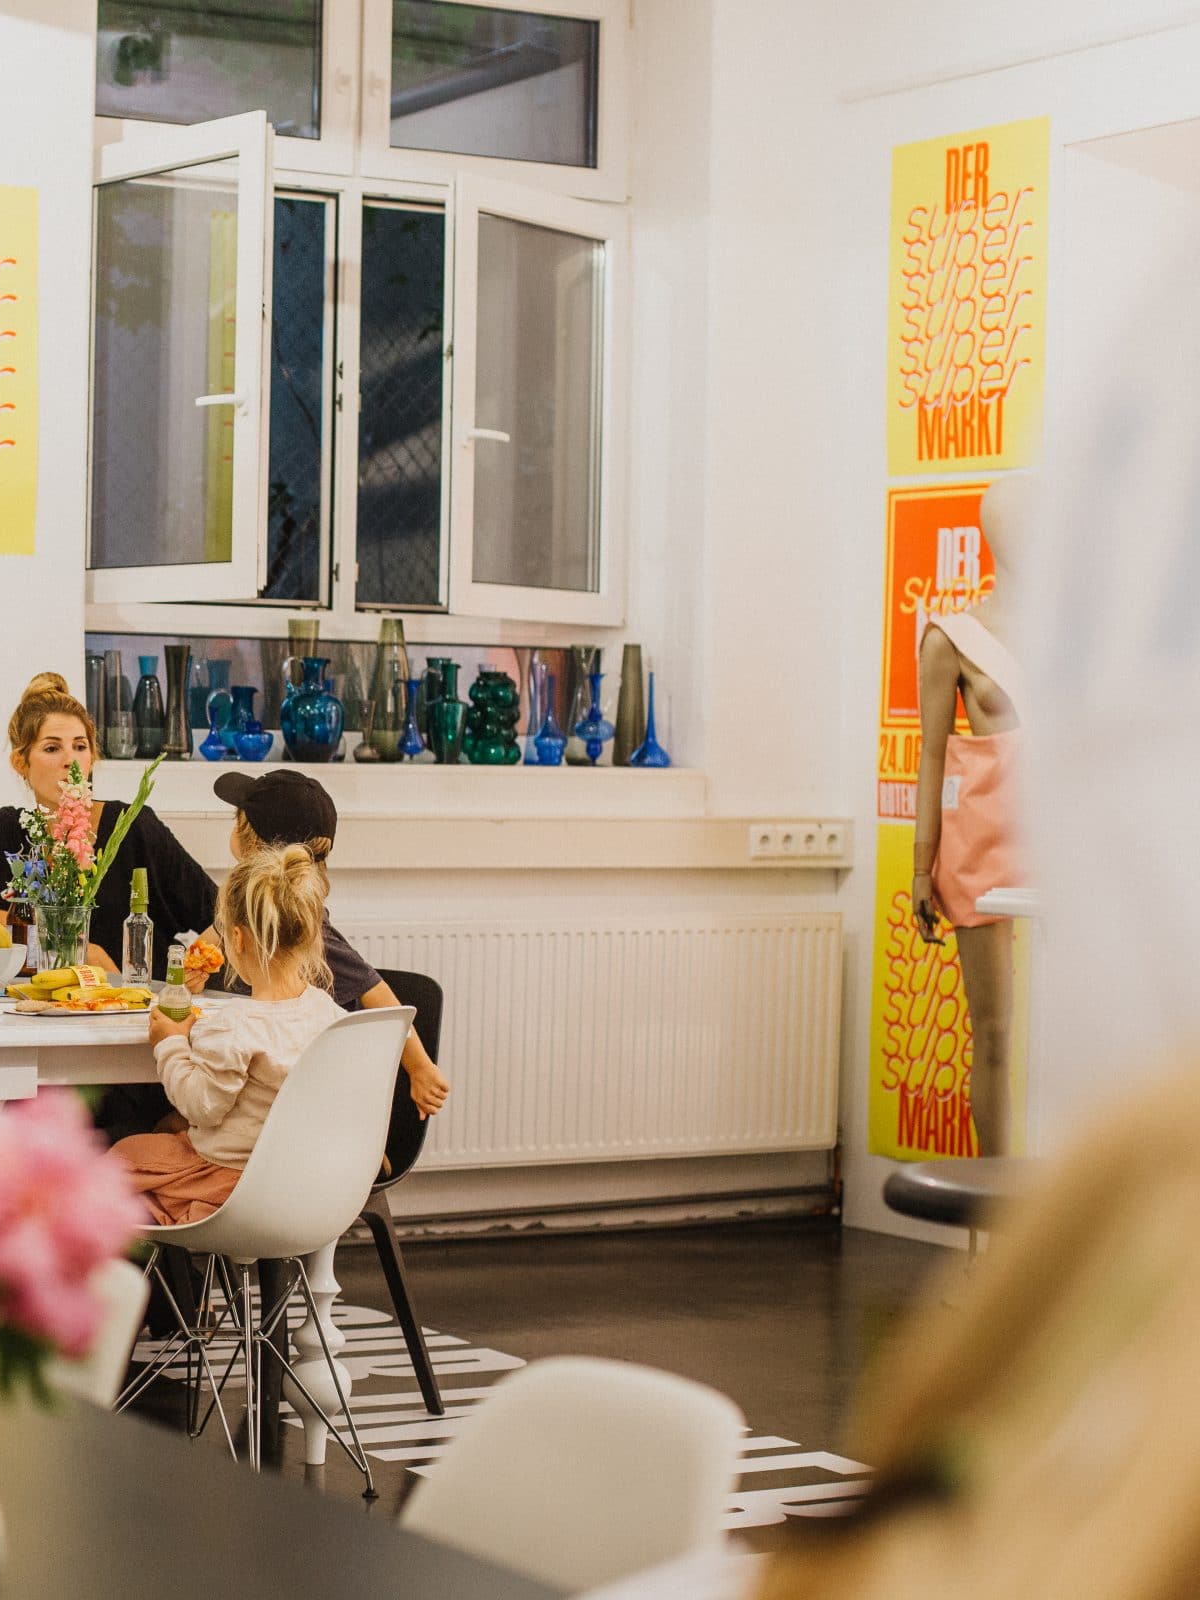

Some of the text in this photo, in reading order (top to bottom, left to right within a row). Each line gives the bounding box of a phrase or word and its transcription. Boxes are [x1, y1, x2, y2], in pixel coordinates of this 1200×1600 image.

[945, 141, 990, 215] DER
[903, 188, 1034, 248] super
[903, 222, 1033, 282] super
[902, 256, 1032, 317] super
[901, 291, 1032, 351] super
[900, 325, 1031, 386] super
[899, 360, 1030, 420] super
[918, 387, 1007, 461] MARKT
[936, 526, 981, 591] DER
[900, 574, 996, 616] supe
[884, 958, 960, 1013] sup
[882, 990, 971, 1046] sup
[882, 1023, 973, 1079] sup
[882, 1056, 971, 1112] sup
[897, 1082, 982, 1158] MARK
